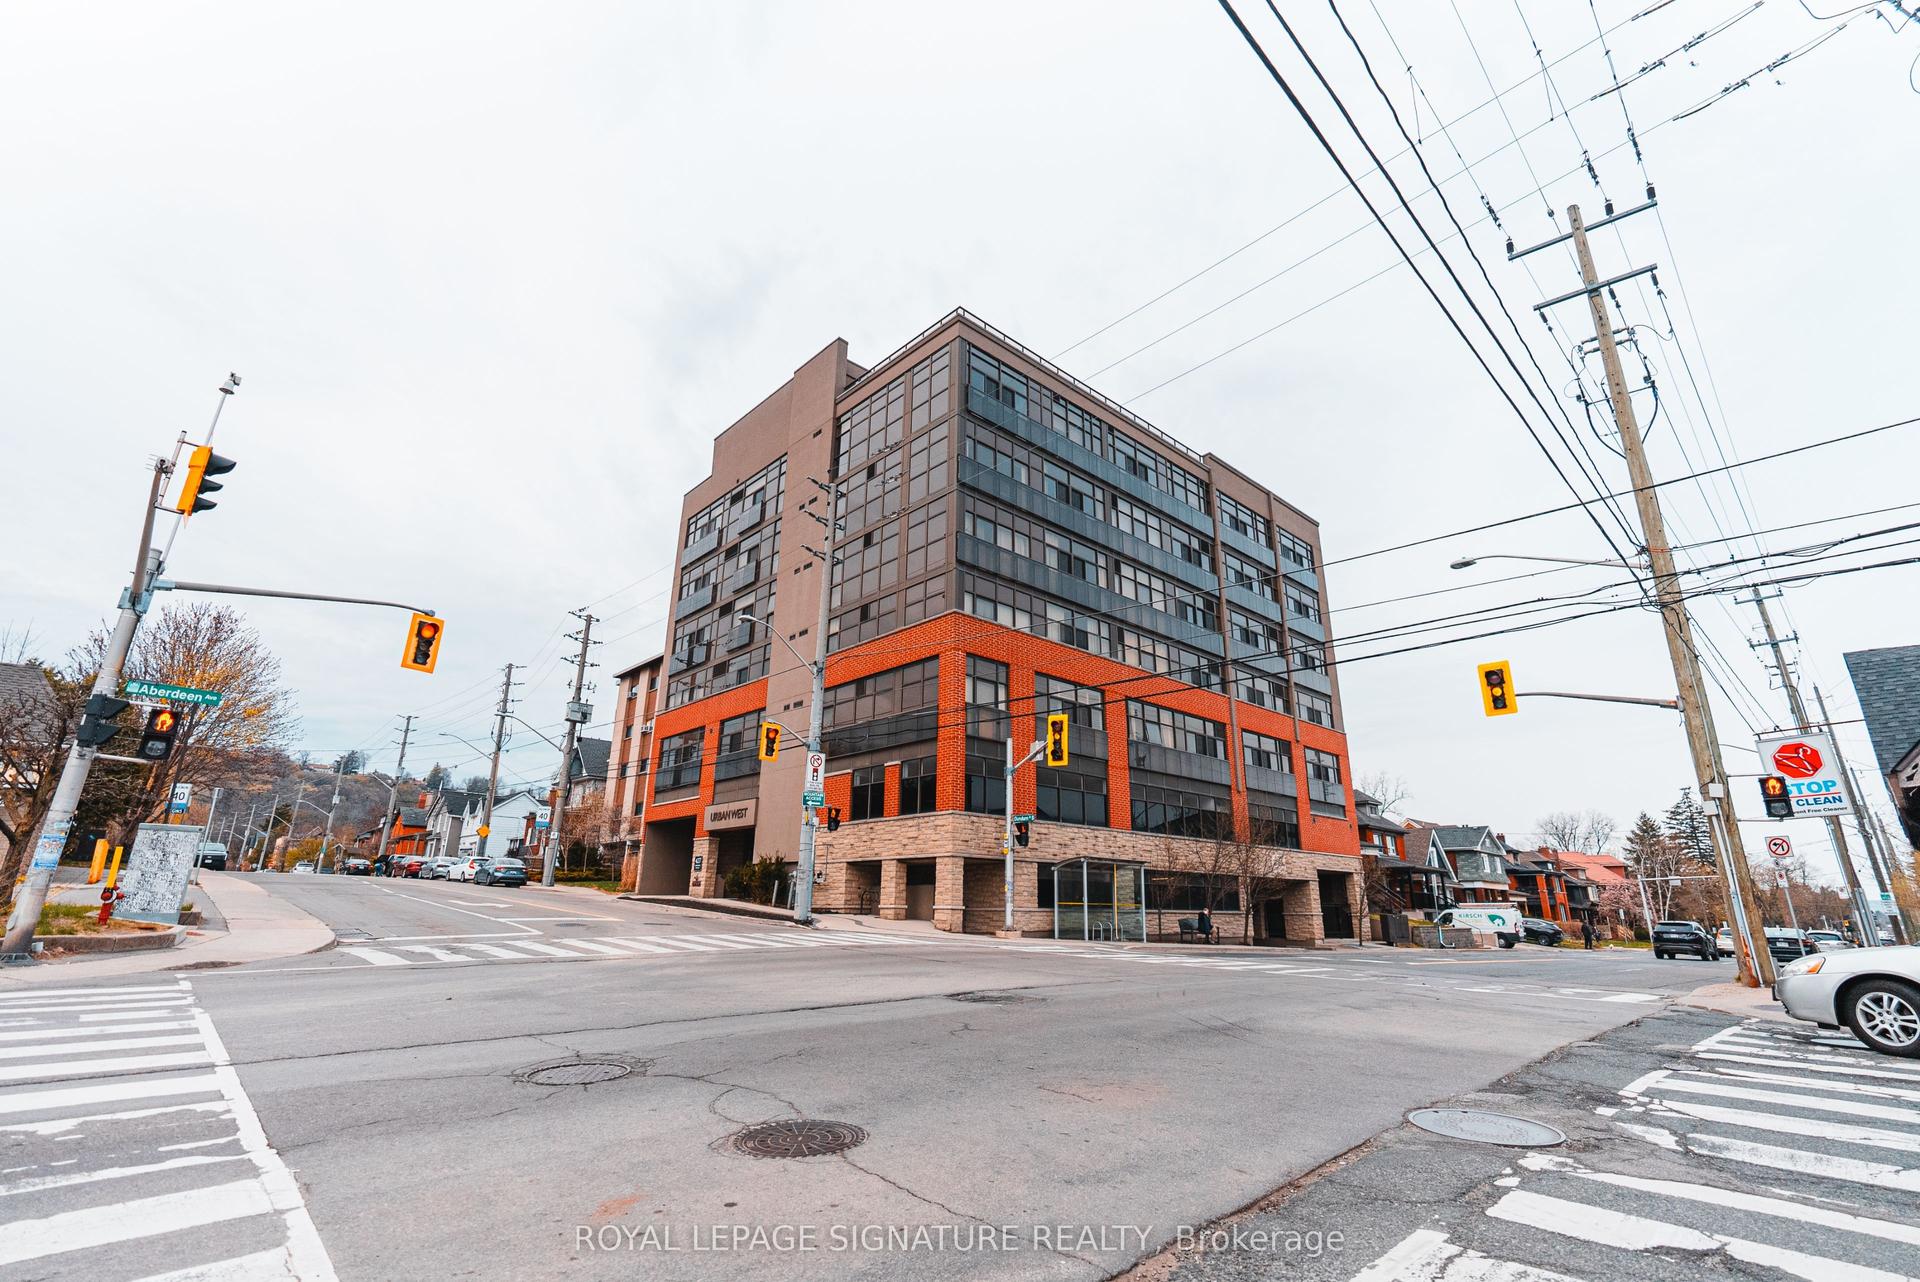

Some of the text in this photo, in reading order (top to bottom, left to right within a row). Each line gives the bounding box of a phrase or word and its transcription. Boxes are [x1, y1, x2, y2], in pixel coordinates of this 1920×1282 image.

[138, 683, 218, 702] Aberdeen Ave
[1796, 795, 1843, 807] CLEAN
[538, 812, 548, 820] 40
[710, 807, 749, 822] URBAN WEST
